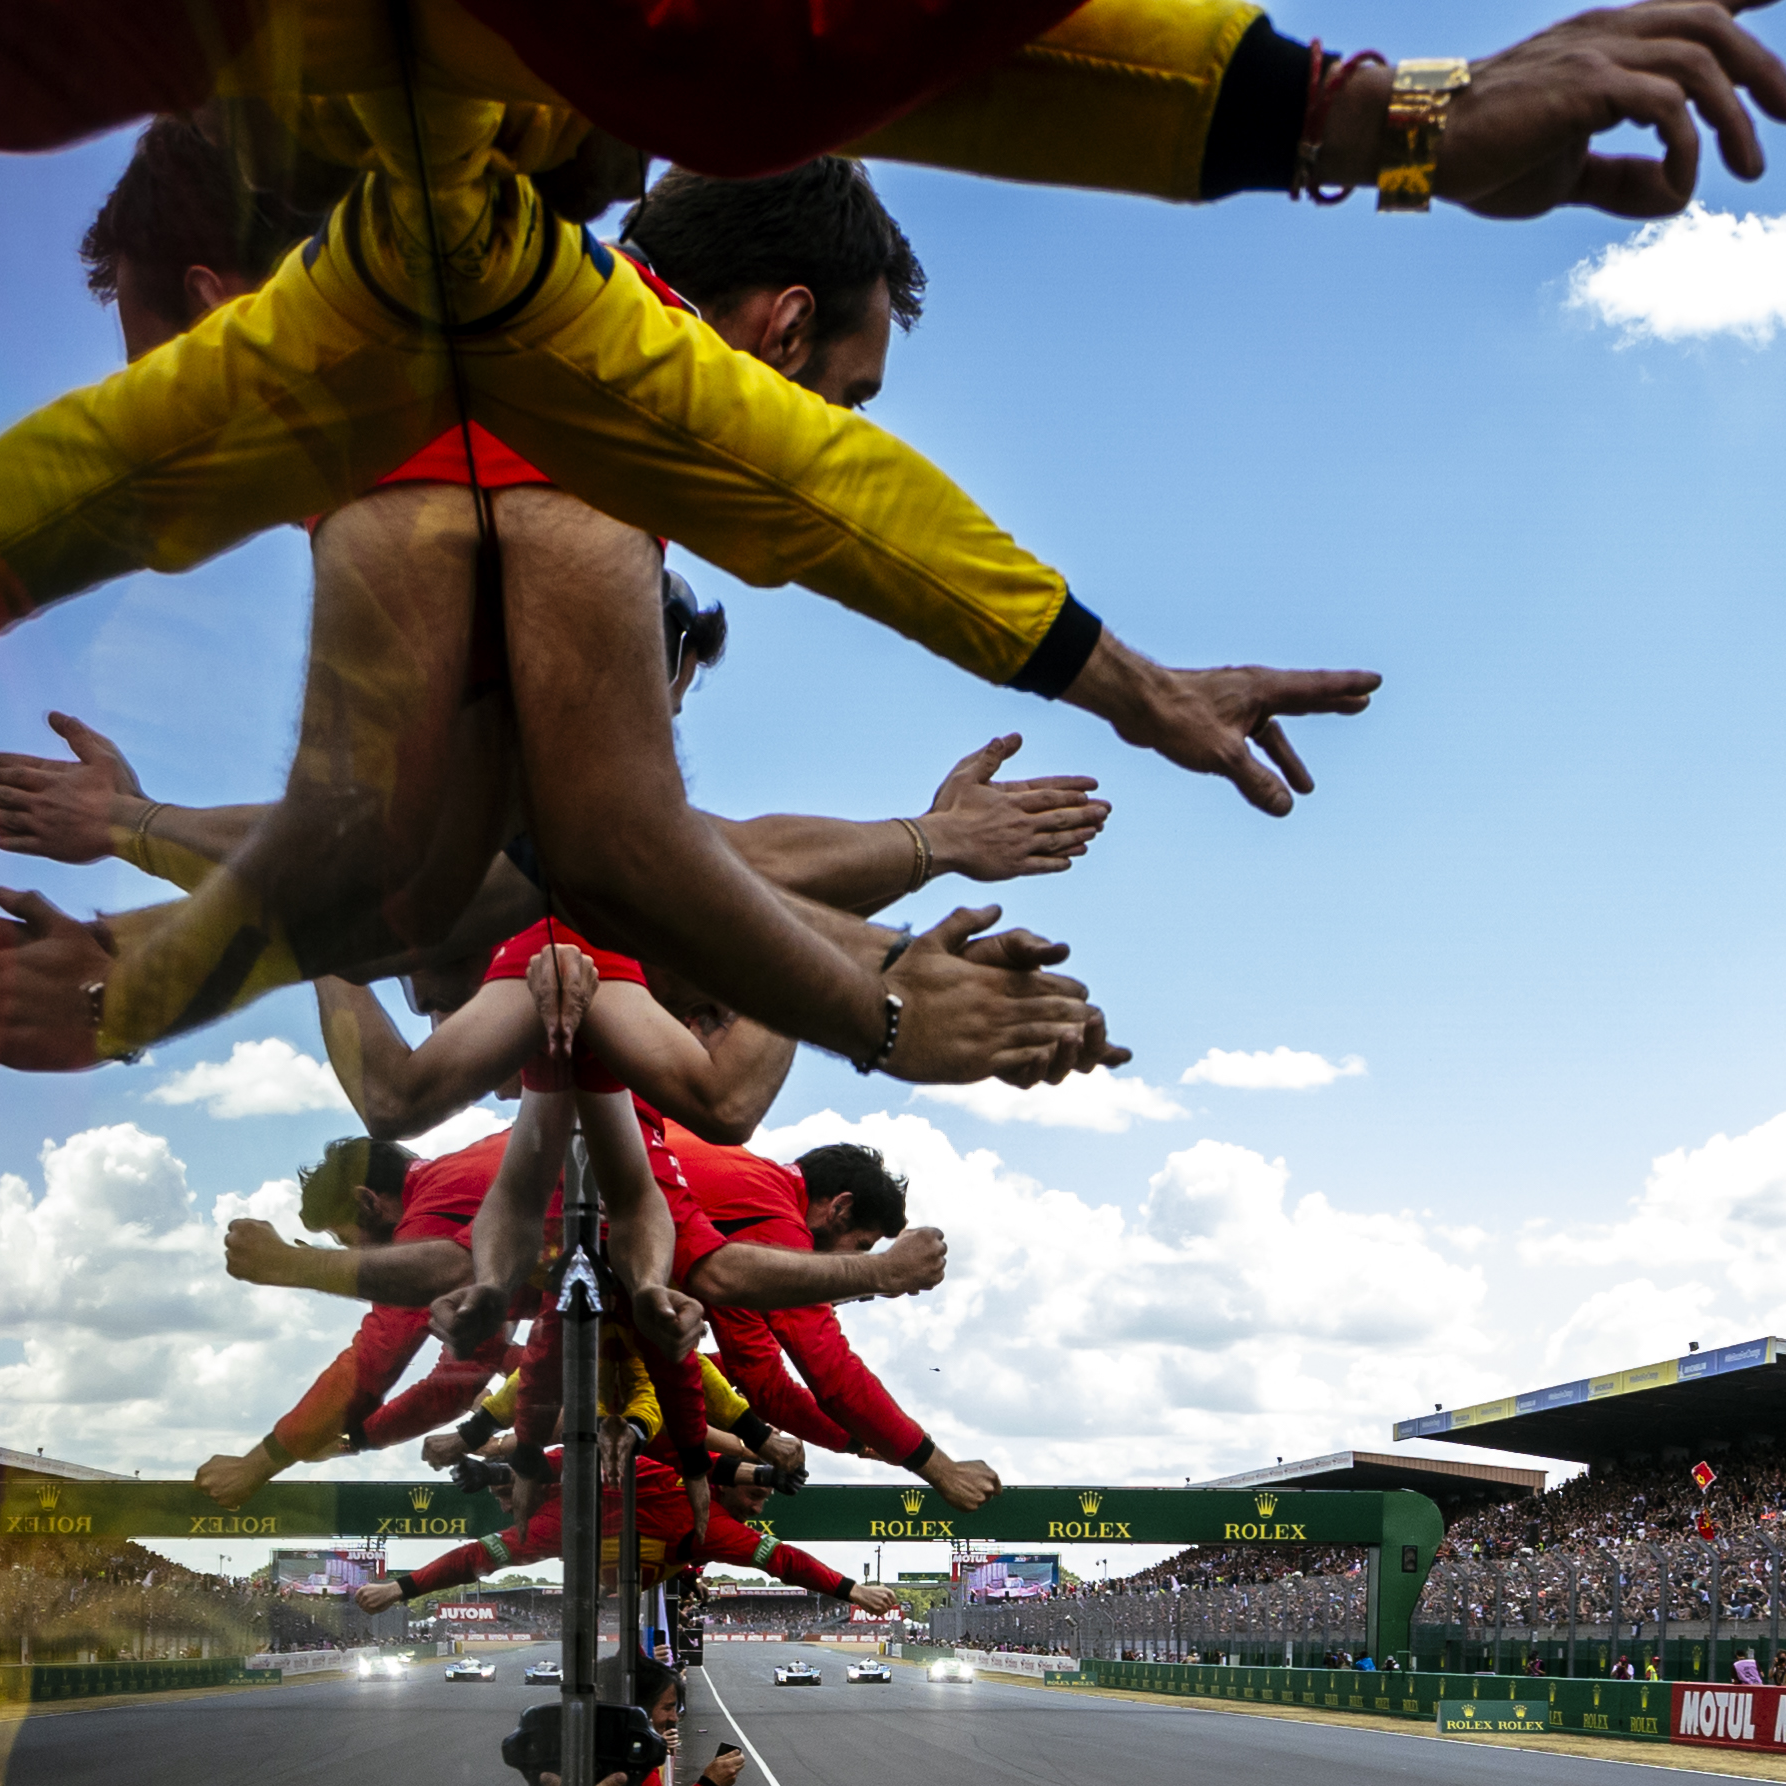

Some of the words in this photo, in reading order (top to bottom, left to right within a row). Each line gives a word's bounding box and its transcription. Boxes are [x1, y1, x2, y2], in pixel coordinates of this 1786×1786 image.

[870, 1520, 953, 1538] ROLEX
[1048, 1521, 1131, 1539] ROLEX
[1224, 1523, 1306, 1541] ROLEX
[1584, 1714, 1609, 1730] ROLEX
[1680, 1690, 1756, 1740] MOTUL
[1447, 1720, 1493, 1730] ROLEX
[1498, 1720, 1544, 1731] ROLEX
[1630, 1717, 1658, 1734] ROLEX
